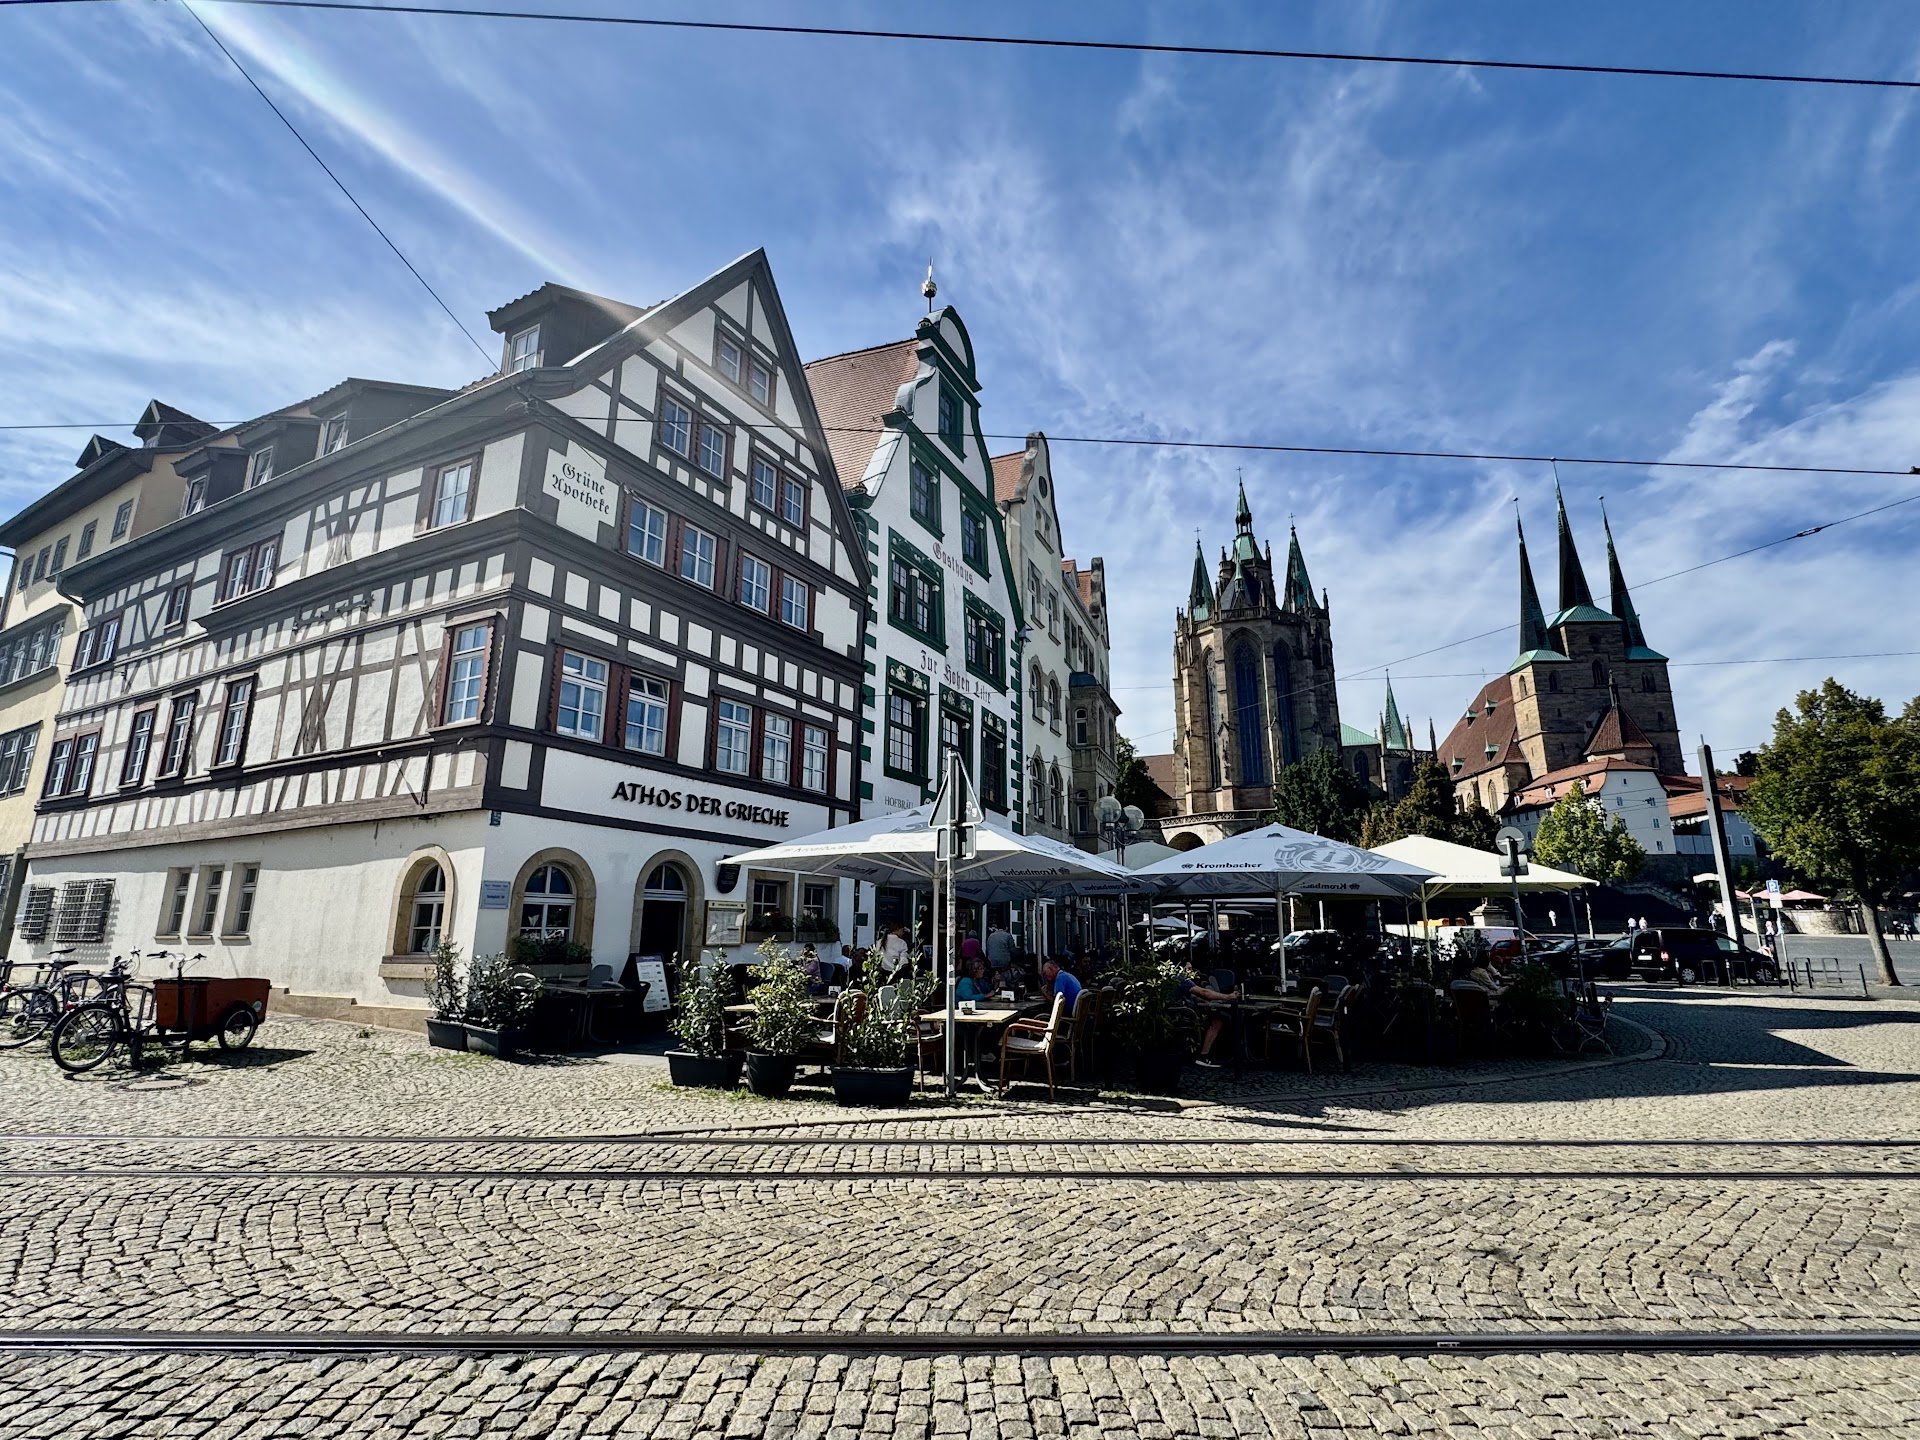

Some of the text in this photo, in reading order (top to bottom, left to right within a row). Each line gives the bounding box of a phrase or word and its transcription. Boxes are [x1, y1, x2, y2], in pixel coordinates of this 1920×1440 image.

[552, 474, 610, 515] Apotheke
[562, 463, 605, 495] Grüne
[933, 542, 974, 586] Gasthaus
[921, 649, 938, 674] Zur
[944, 664, 970, 692] Hohen
[612, 781, 790, 828] ATHOS DER GRIECHE
